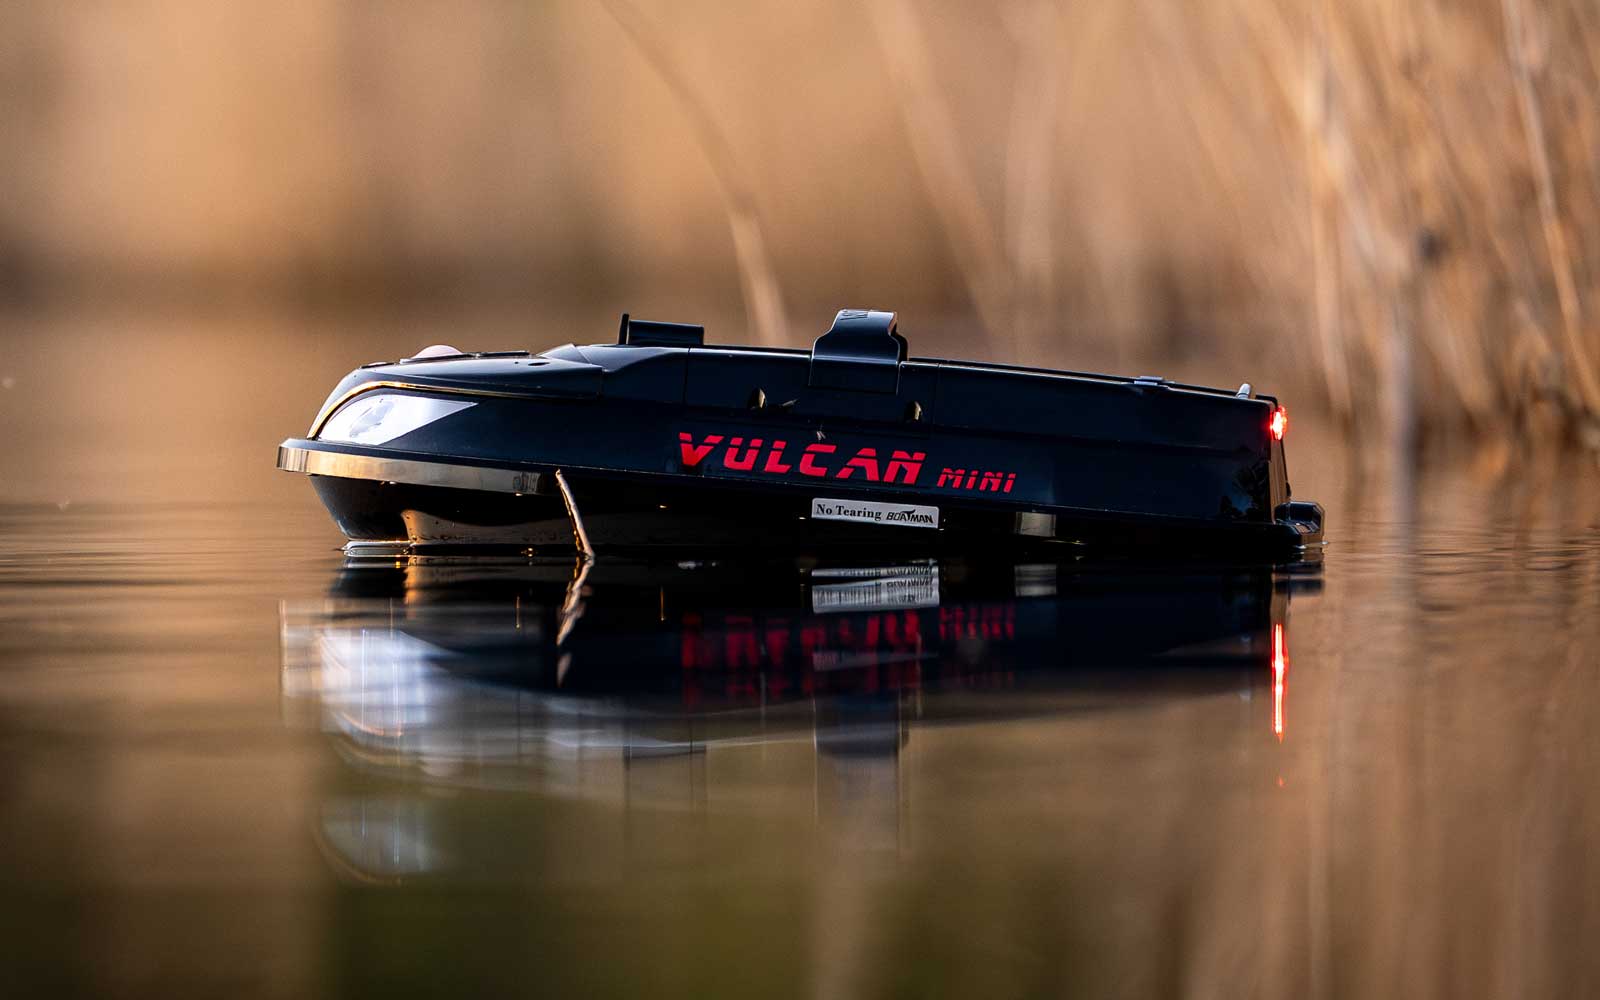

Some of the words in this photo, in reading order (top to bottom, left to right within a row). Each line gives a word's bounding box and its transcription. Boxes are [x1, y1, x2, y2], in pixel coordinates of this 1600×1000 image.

[679, 432, 926, 484] VULCAN
[937, 466, 1016, 493] MINI
[816, 503, 832, 515] No
[836, 505, 883, 521] Tearing
[886, 509, 934, 524] BOATMAN
